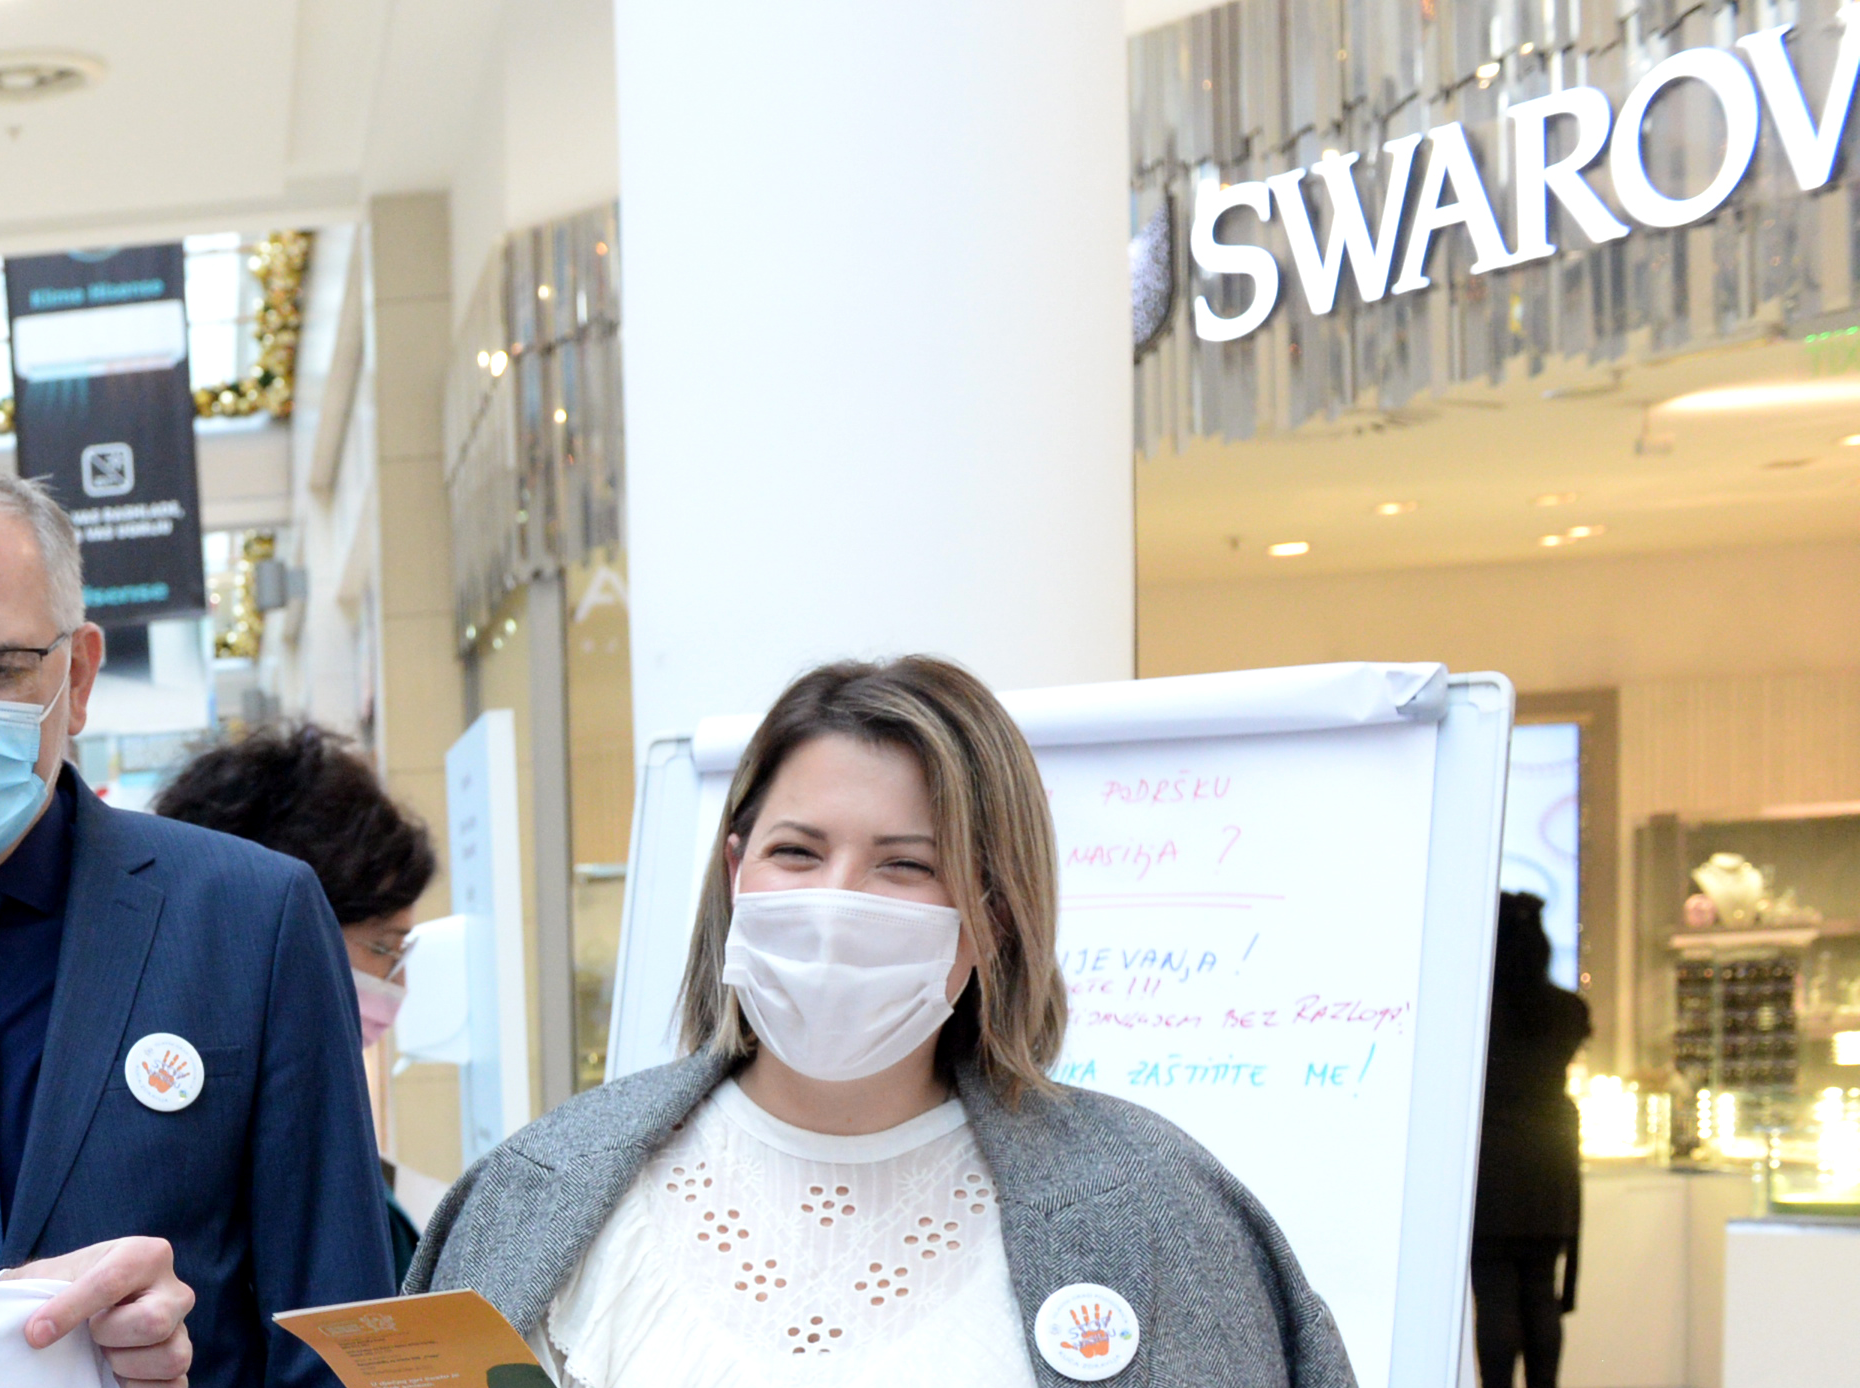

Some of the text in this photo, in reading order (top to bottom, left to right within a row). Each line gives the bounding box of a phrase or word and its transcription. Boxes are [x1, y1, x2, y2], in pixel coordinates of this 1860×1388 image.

[1191, 0, 1860, 342] SWAROV
[82, 581, 170, 608] isense
[1059, 947, 1219, 983] IJEVANJA
